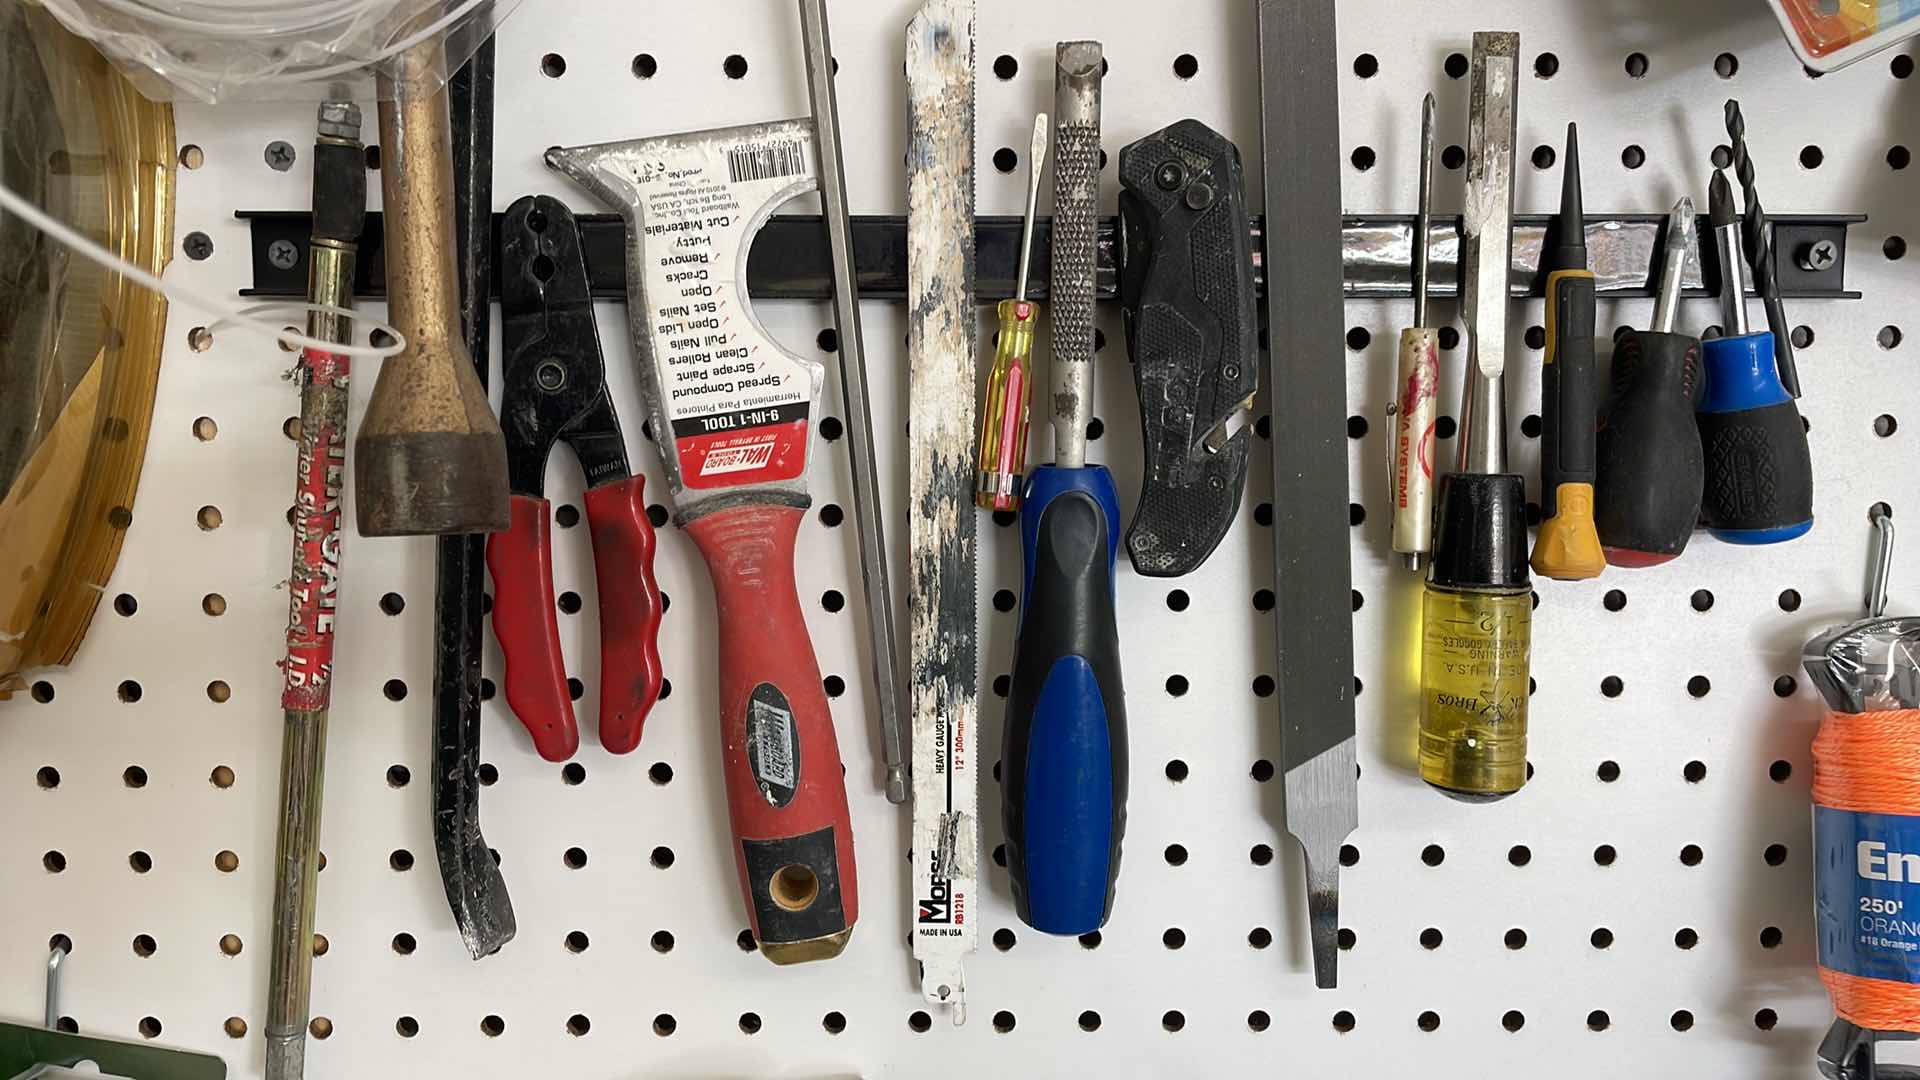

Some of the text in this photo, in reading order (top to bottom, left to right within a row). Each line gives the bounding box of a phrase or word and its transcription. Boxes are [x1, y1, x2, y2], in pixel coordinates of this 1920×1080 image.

[649, 190, 677, 201] Reserved
[678, 188, 696, 196] Rights
[712, 193, 731, 204] Long
[650, 201, 668, 211] USA
[669, 200, 682, 208] CA
[701, 201, 740, 213] Wallboard
[645, 216, 730, 235] Cut Materials
[660, 253, 708, 266] Remove
[666, 270, 708, 283] Cracks
[681, 284, 712, 297] Open
[659, 302, 716, 317] Set Nails
[658, 317, 719, 335] Open Lids
[670, 333, 727, 350] Pull Nails
[668, 347, 748, 366] Clean Rollers
[677, 362, 755, 382] Scrape Paint
[672, 374, 780, 400] Spread Compound
[676, 392, 801, 416] Herramienta Para Pintores
[701, 409, 779, 431] 9-IN-1 TOOL
[1398, 436, 1409, 510] SYSTEMS
[1470, 649, 1519, 661] WARNING
[936, 720, 944, 747] GAUGE
[955, 721, 964, 752] 300mm
[936, 749, 944, 774] HEAVY
[954, 893, 964, 925] RB1218
[1860, 915, 1920, 937] ORAN
[1880, 938, 1917, 952] Orange
